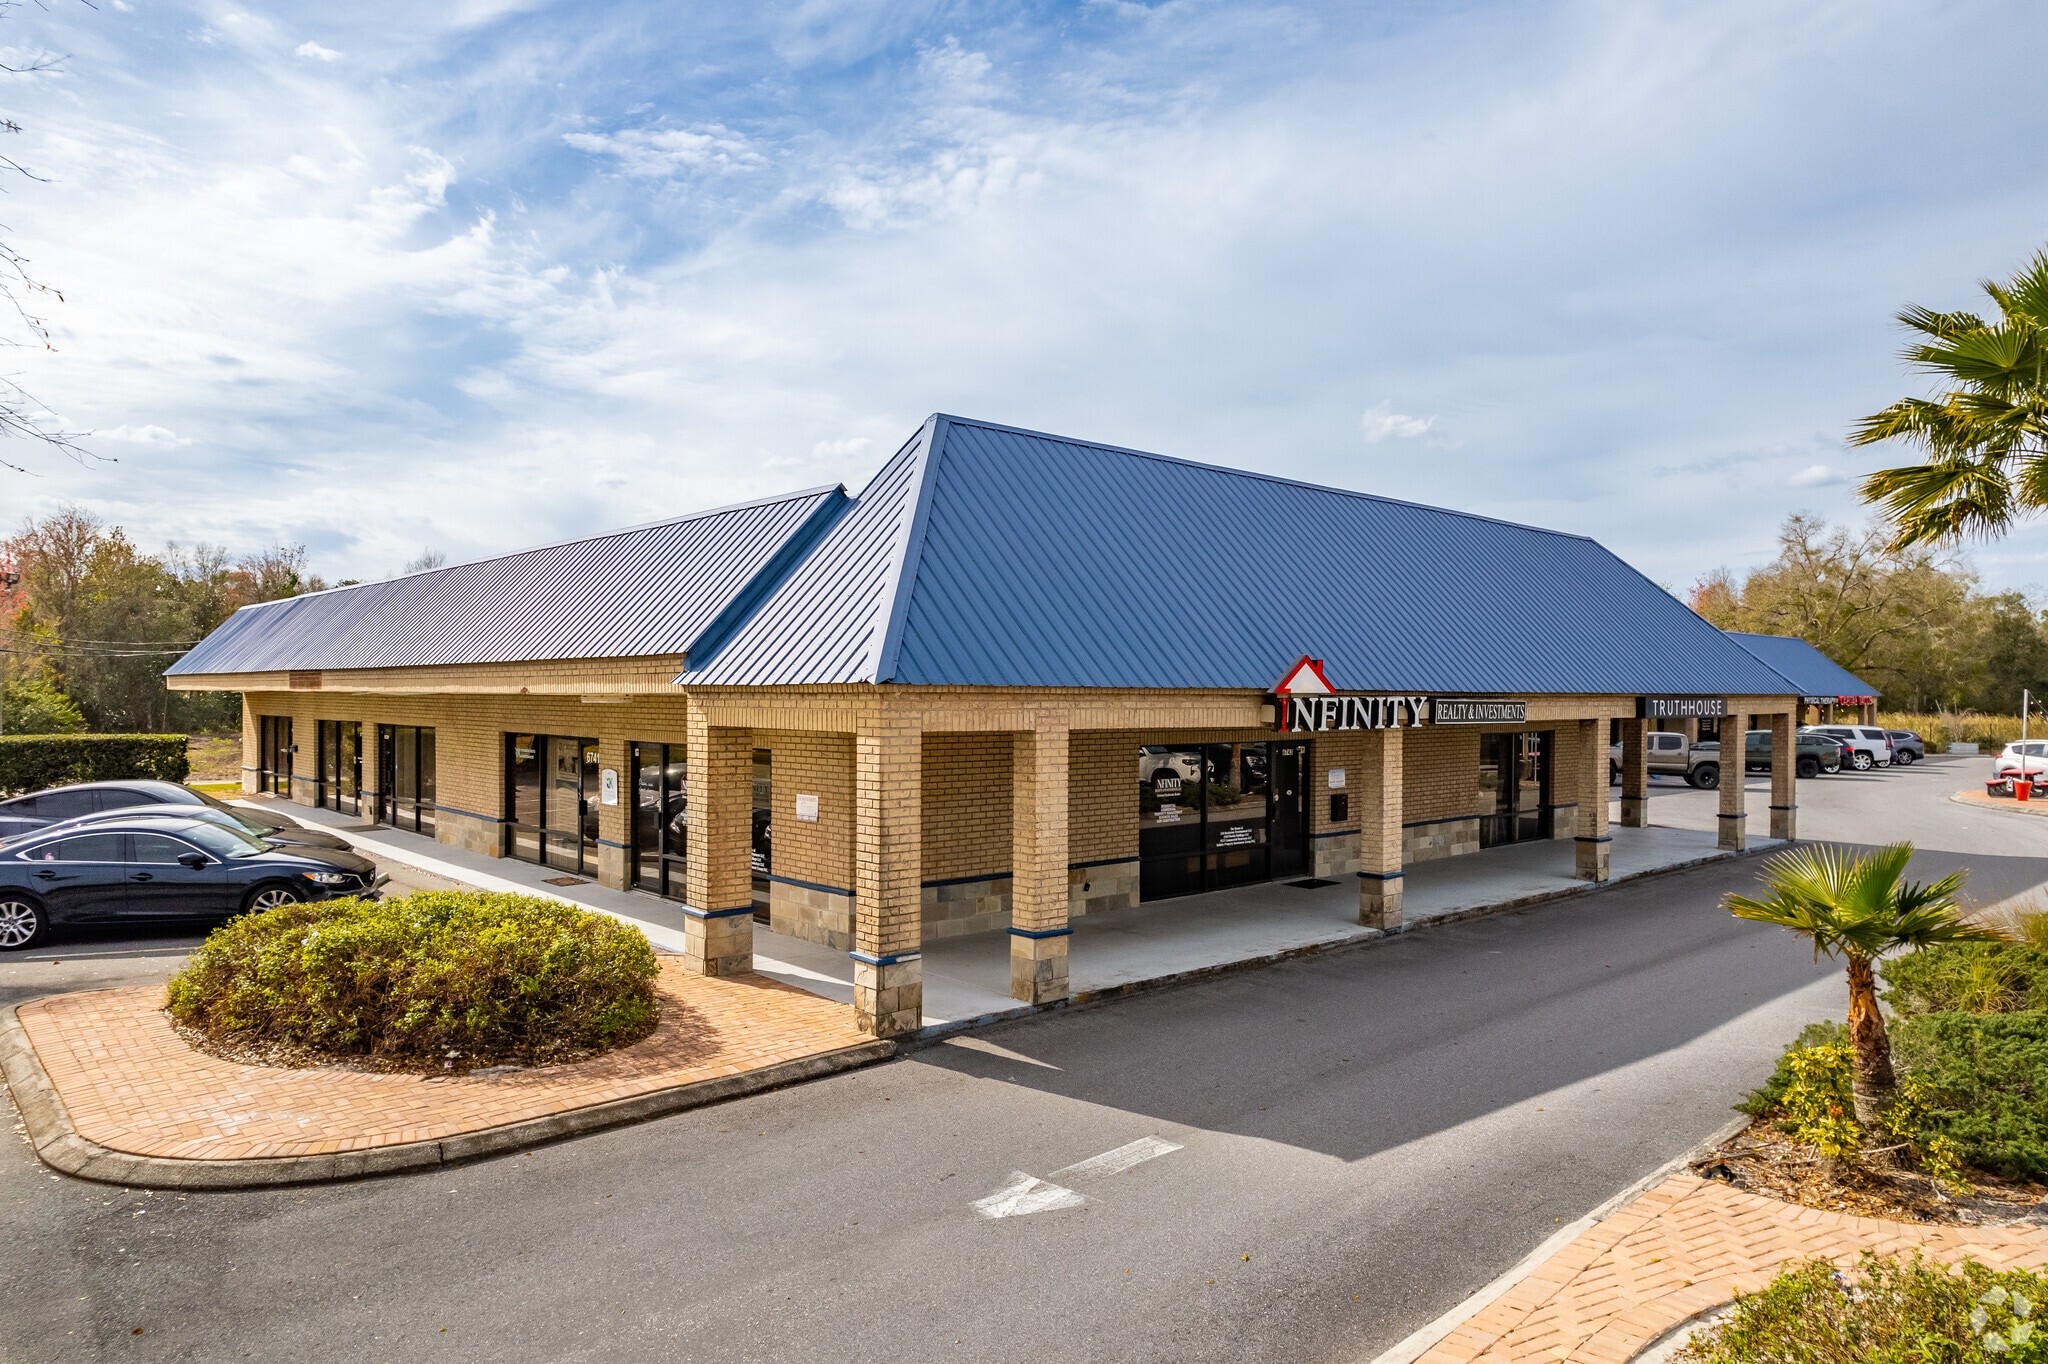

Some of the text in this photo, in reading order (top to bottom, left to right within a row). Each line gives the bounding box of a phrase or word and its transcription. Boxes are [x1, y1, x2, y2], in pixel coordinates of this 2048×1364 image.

[1652, 699, 1723, 717] TRUTHHOUSE
[1804, 696, 1836, 705] PHYSICAL THERAPY
[1279, 697, 1428, 732] INFINITY
[1437, 703, 1526, 720] REALTY & INVESTMENTS
[586, 751, 600, 764] 6741
